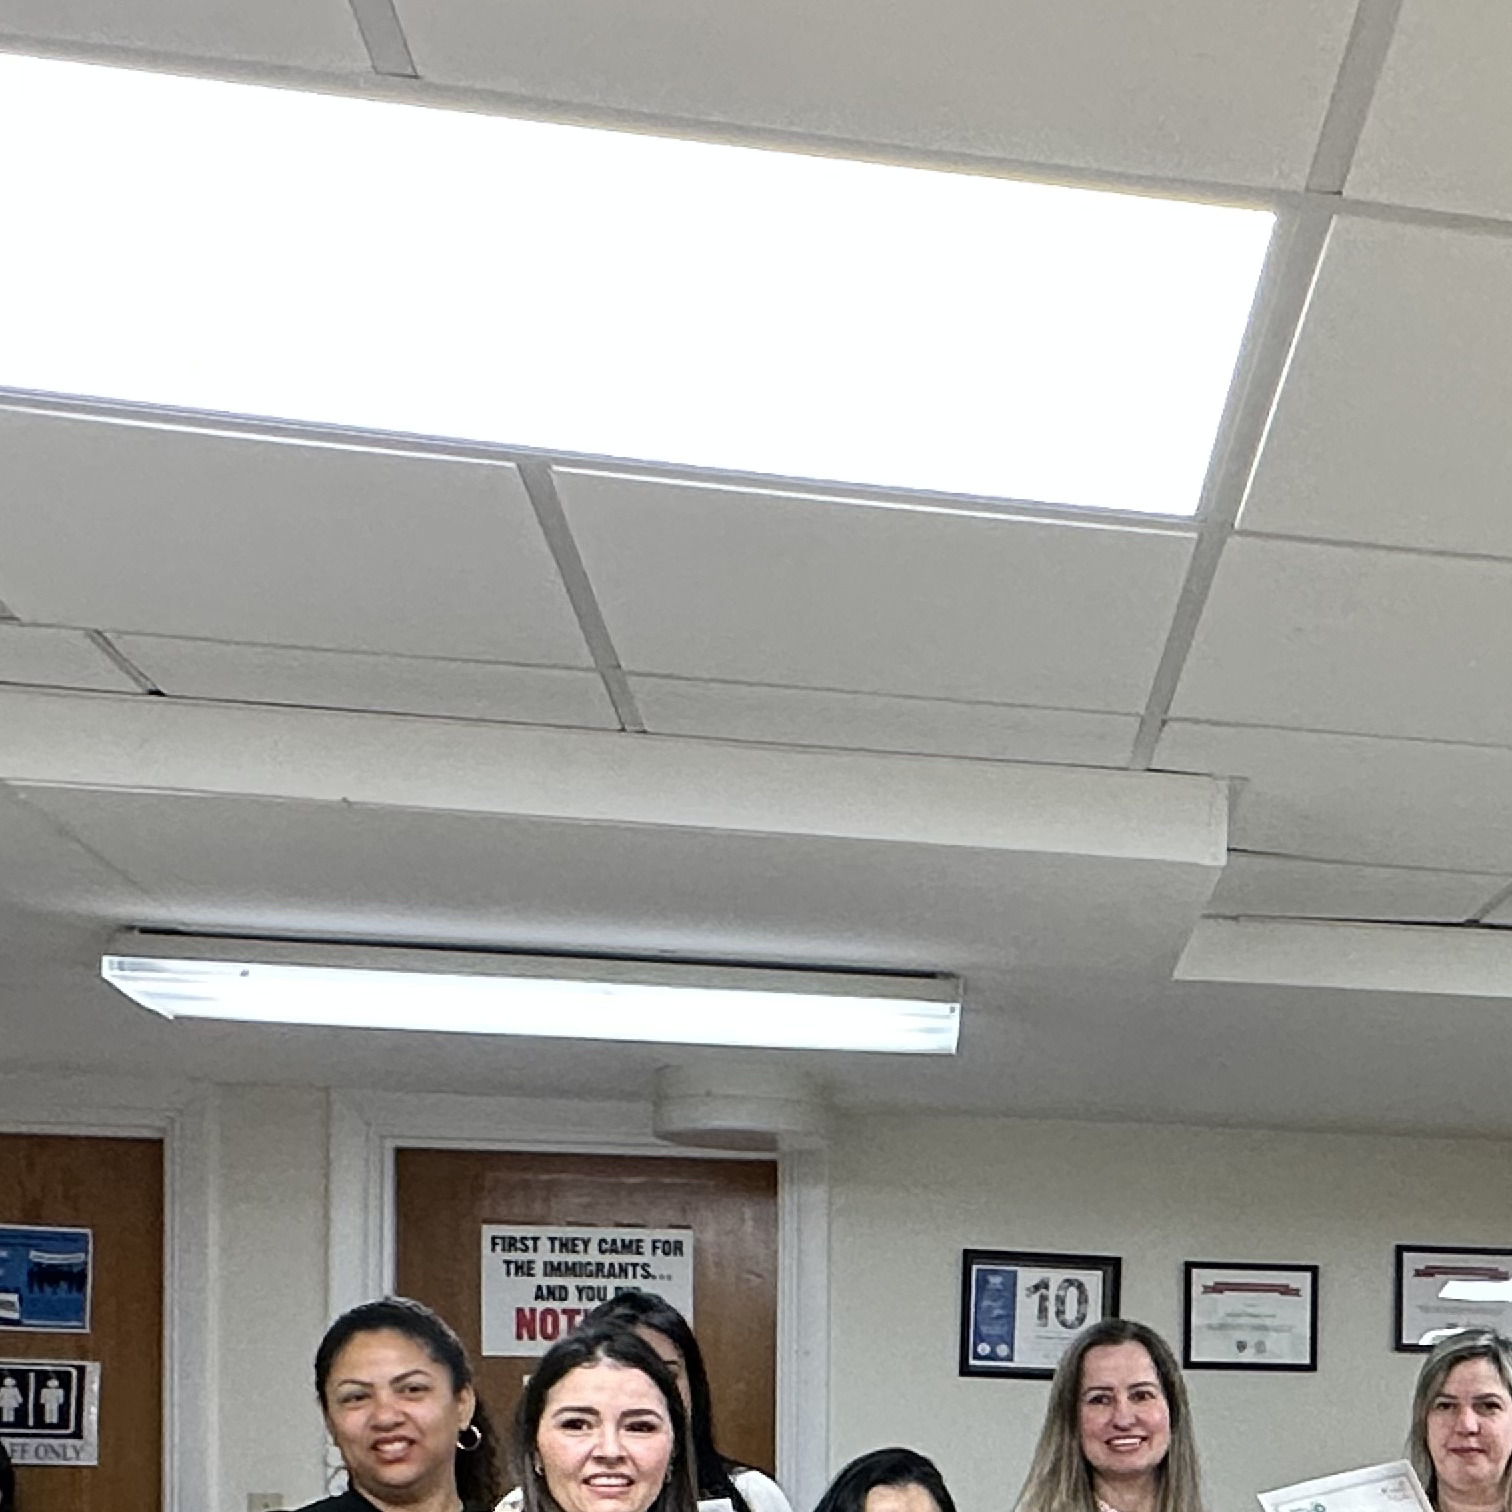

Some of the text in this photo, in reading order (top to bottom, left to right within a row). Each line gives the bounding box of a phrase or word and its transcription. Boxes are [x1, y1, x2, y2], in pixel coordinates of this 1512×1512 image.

[490, 1236, 684, 1257] FIRST THEY CAME FOR
[503, 1259, 672, 1281] THE IMMIGRANTS...
[534, 1284, 569, 1302] AND
[574, 1284, 608, 1302] YOU
[1024, 1277, 1089, 1329] 10
[34, 1442, 84, 1461] ONLY
